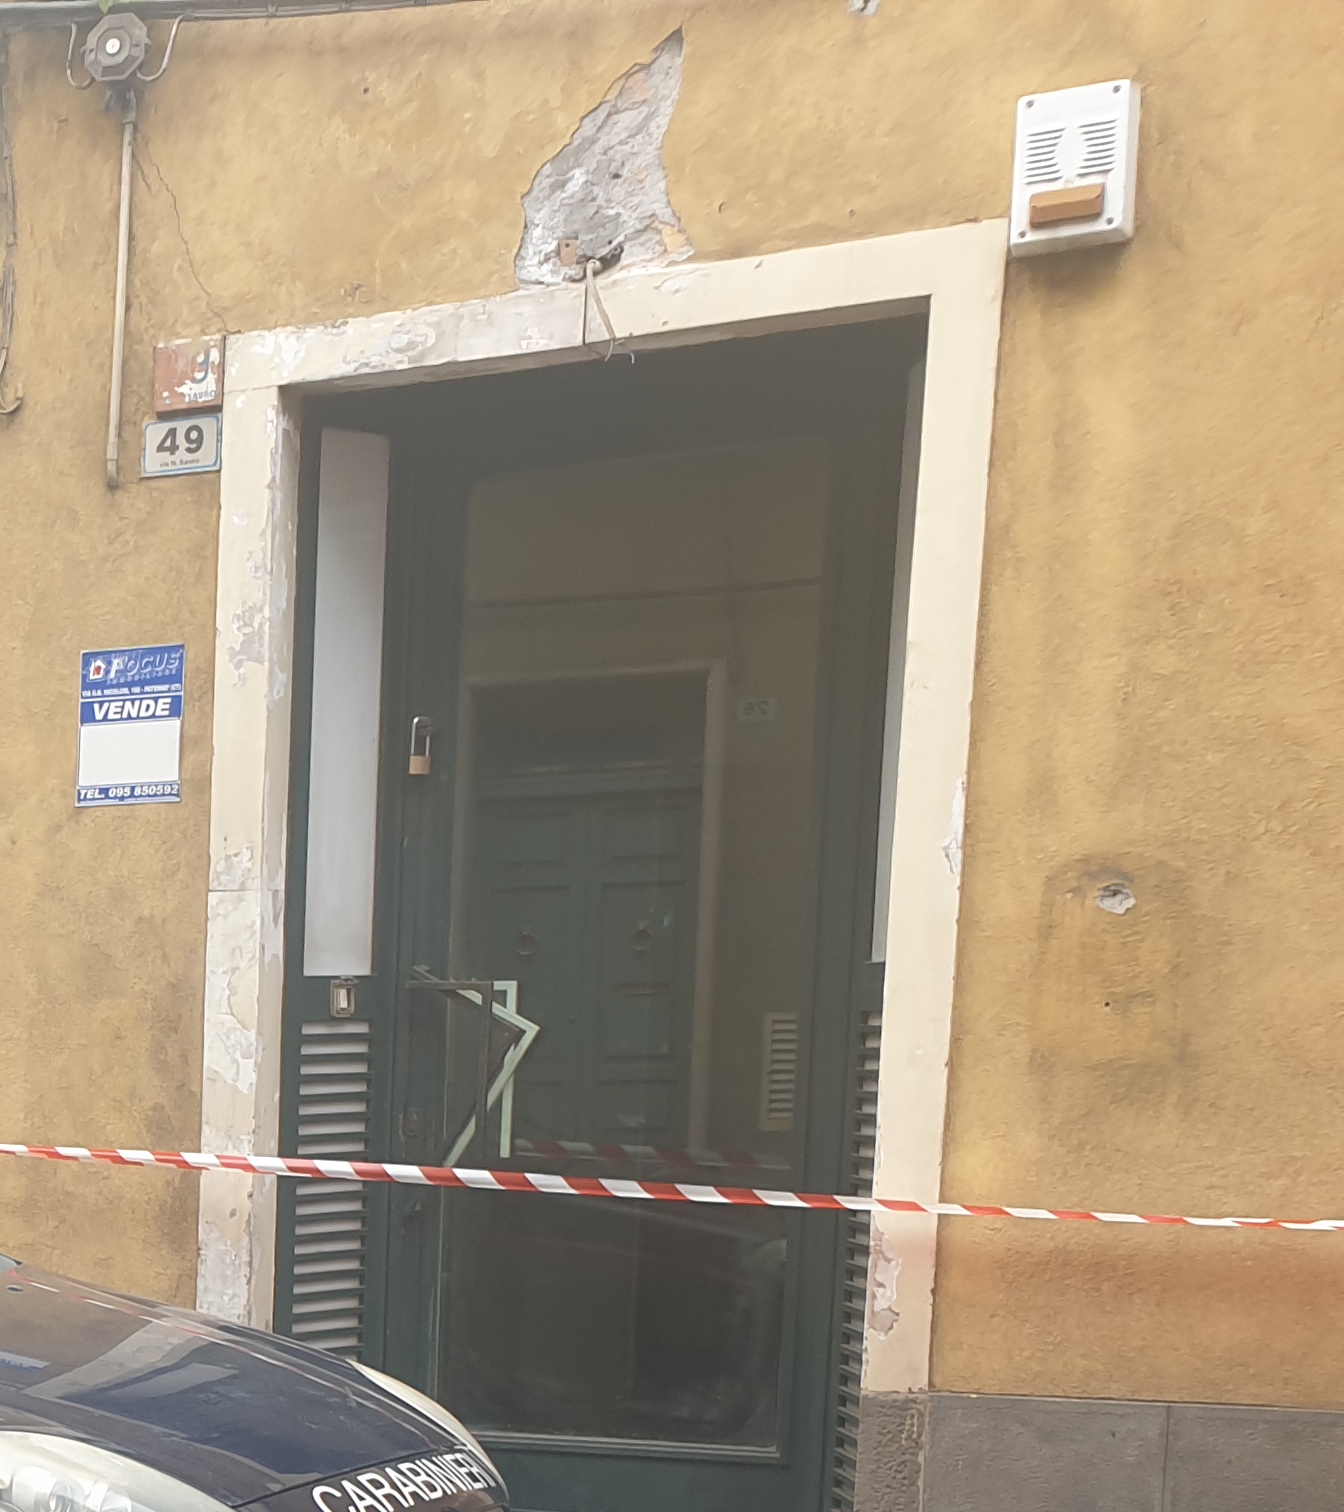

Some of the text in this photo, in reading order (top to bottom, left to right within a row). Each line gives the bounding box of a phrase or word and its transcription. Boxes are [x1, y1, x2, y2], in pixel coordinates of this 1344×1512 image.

[155, 424, 205, 456] 49
[93, 697, 172, 721] VENDE
[79, 784, 179, 800] TEL. 095 850592
